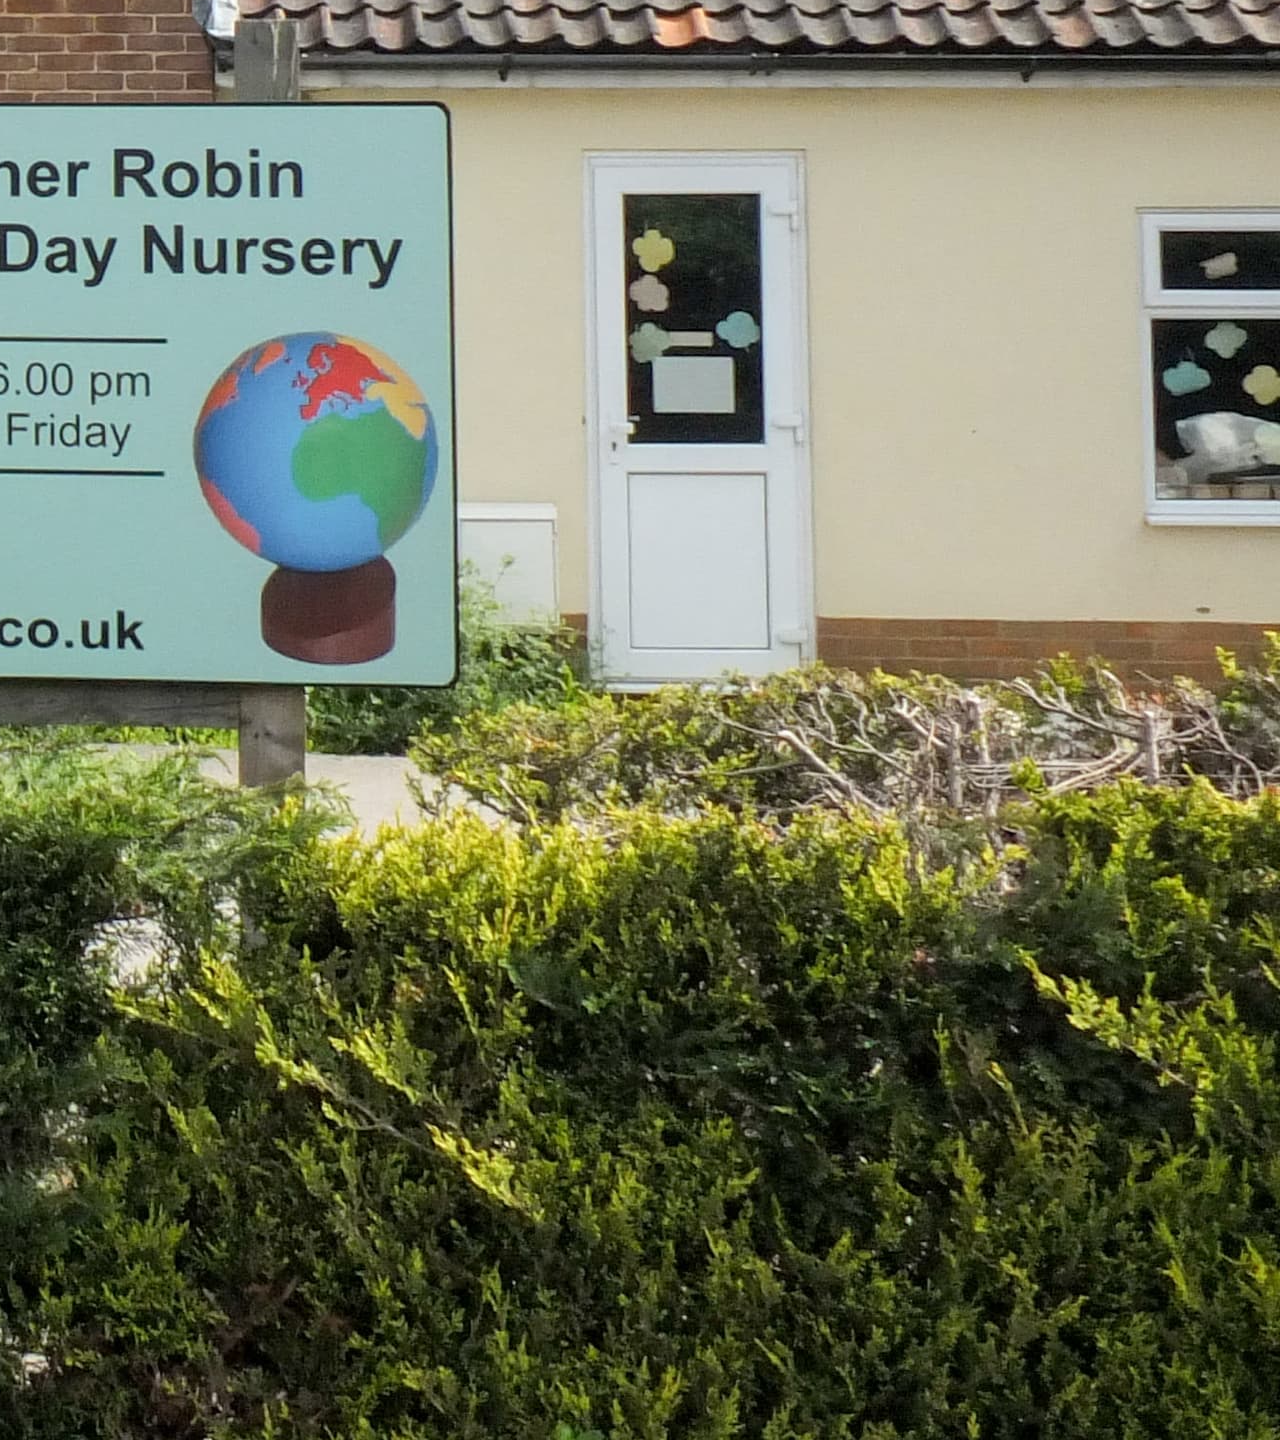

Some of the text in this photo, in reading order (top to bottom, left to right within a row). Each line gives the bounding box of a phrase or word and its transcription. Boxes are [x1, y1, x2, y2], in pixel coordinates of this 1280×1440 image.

[113, 148, 303, 199] Robin
[143, 224, 403, 290] Nursery
[90, 371, 151, 406] pm
[7, 412, 131, 458] Friday
